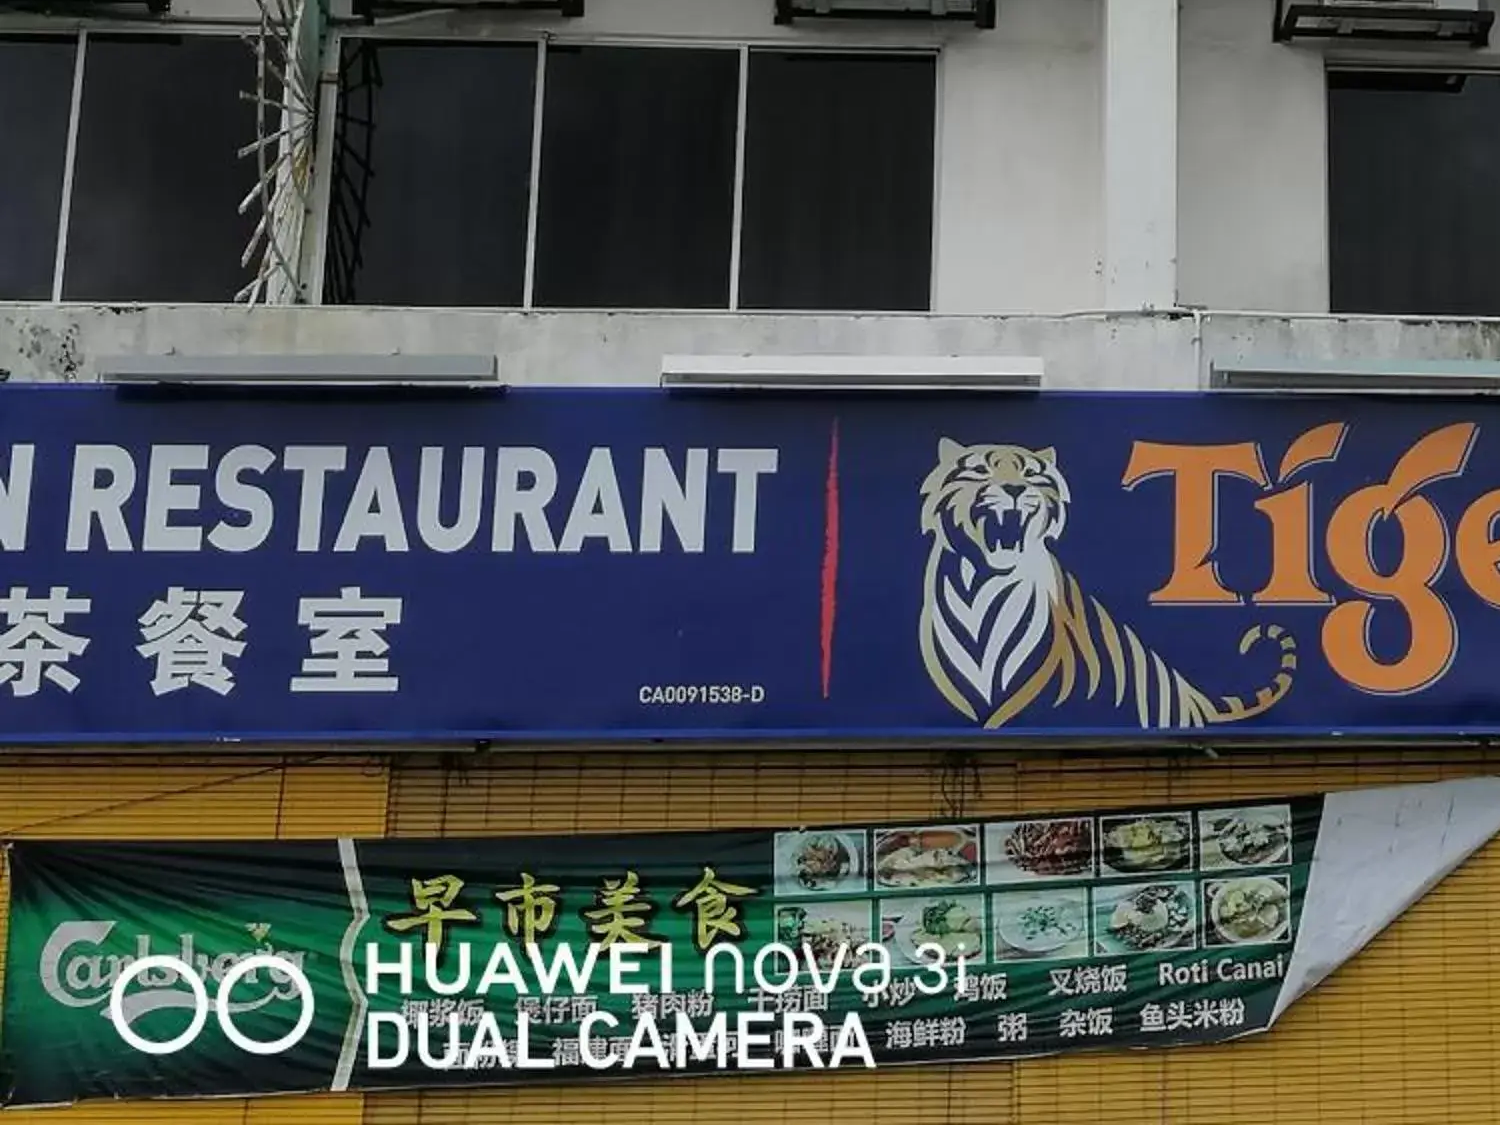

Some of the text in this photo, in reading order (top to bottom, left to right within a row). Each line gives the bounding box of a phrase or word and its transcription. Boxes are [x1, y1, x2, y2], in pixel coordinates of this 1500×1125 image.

[65, 444, 779, 553] RESTAURANT
[0, 586, 403, 697] 茶餐室
[386, 866, 758, 953] 早市美食
[1047, 964, 1128, 997] 叉烧饭
[1158, 952, 1284, 987] Roti Canai
[996, 1012, 1028, 1042] 粥
[1058, 1006, 1114, 1037] 杂饭
[1138, 997, 1246, 1033] 鱼头米粉
[885, 1018, 967, 1050] 海鲜粉
